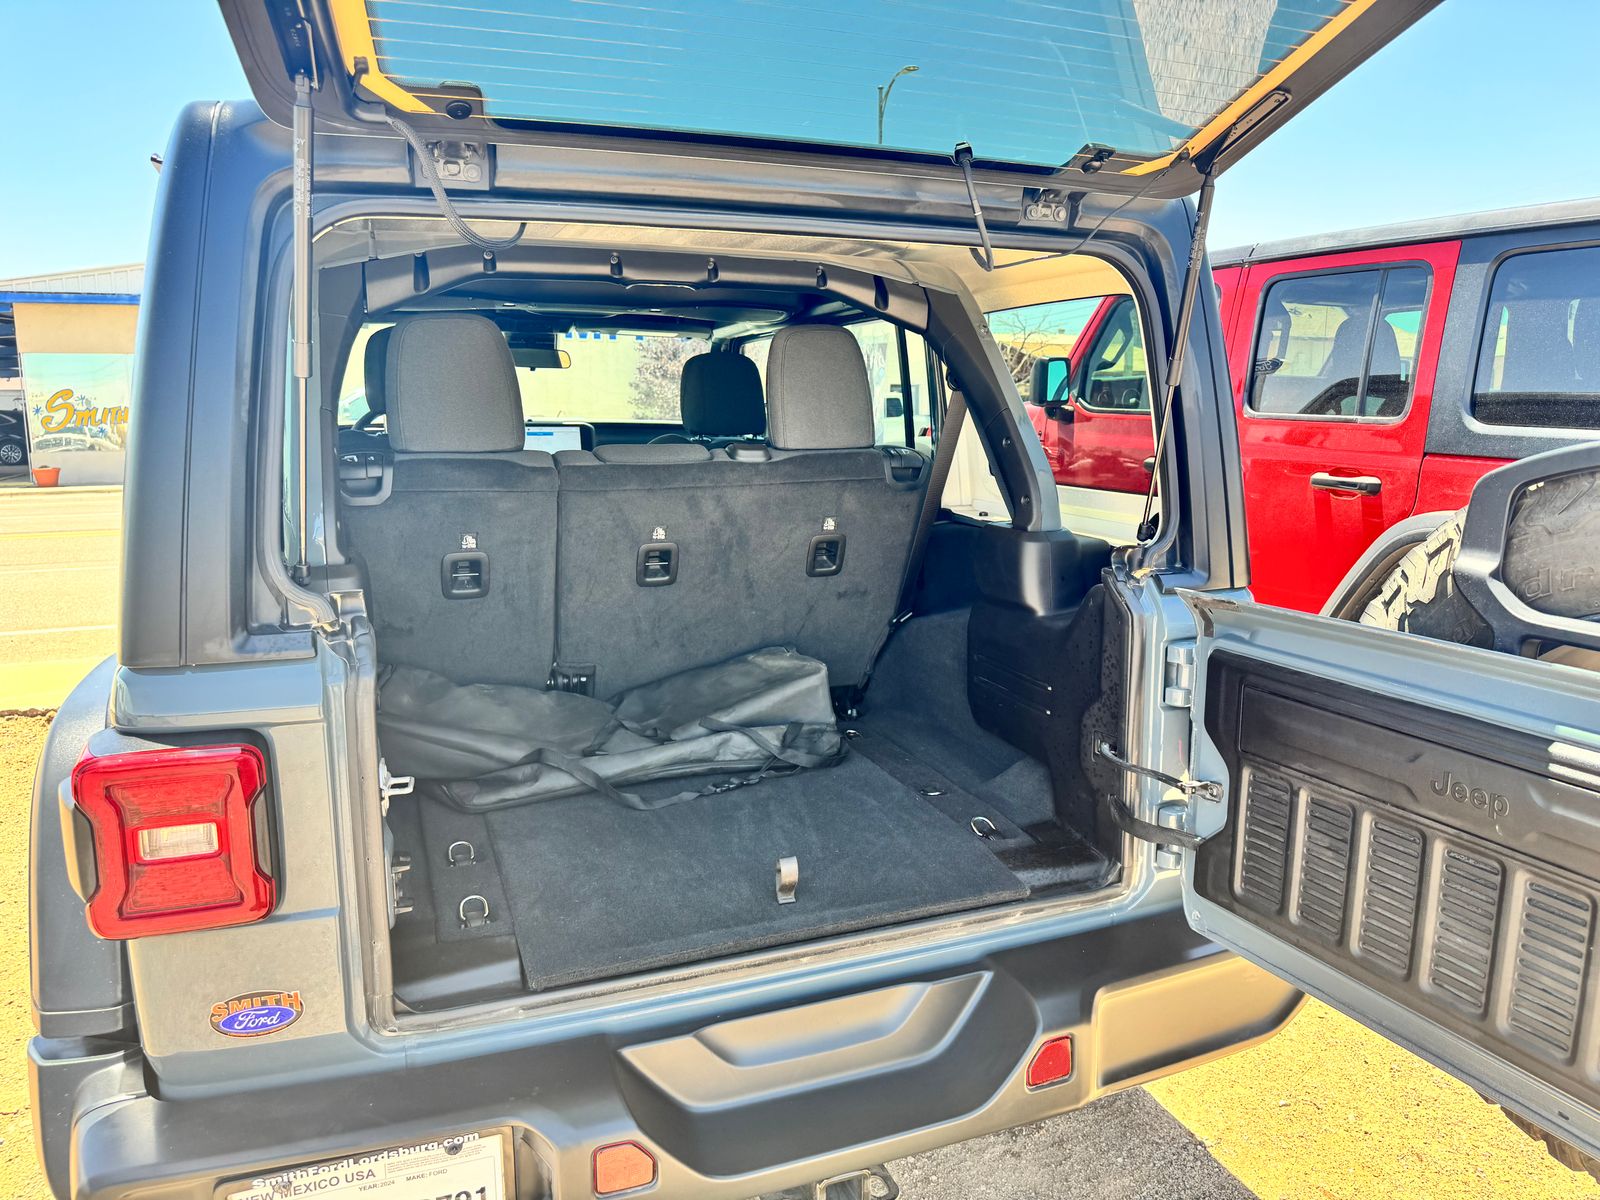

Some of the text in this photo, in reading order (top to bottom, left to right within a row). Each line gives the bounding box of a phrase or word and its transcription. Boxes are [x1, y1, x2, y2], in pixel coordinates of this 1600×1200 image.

[1430, 771, 1510, 820] Jeep
[211, 990, 301, 1022] SMITH
[234, 1009, 281, 1030] Ford
[345, 1169, 376, 1183] USA
[429, 1169, 448, 1178] FORD
